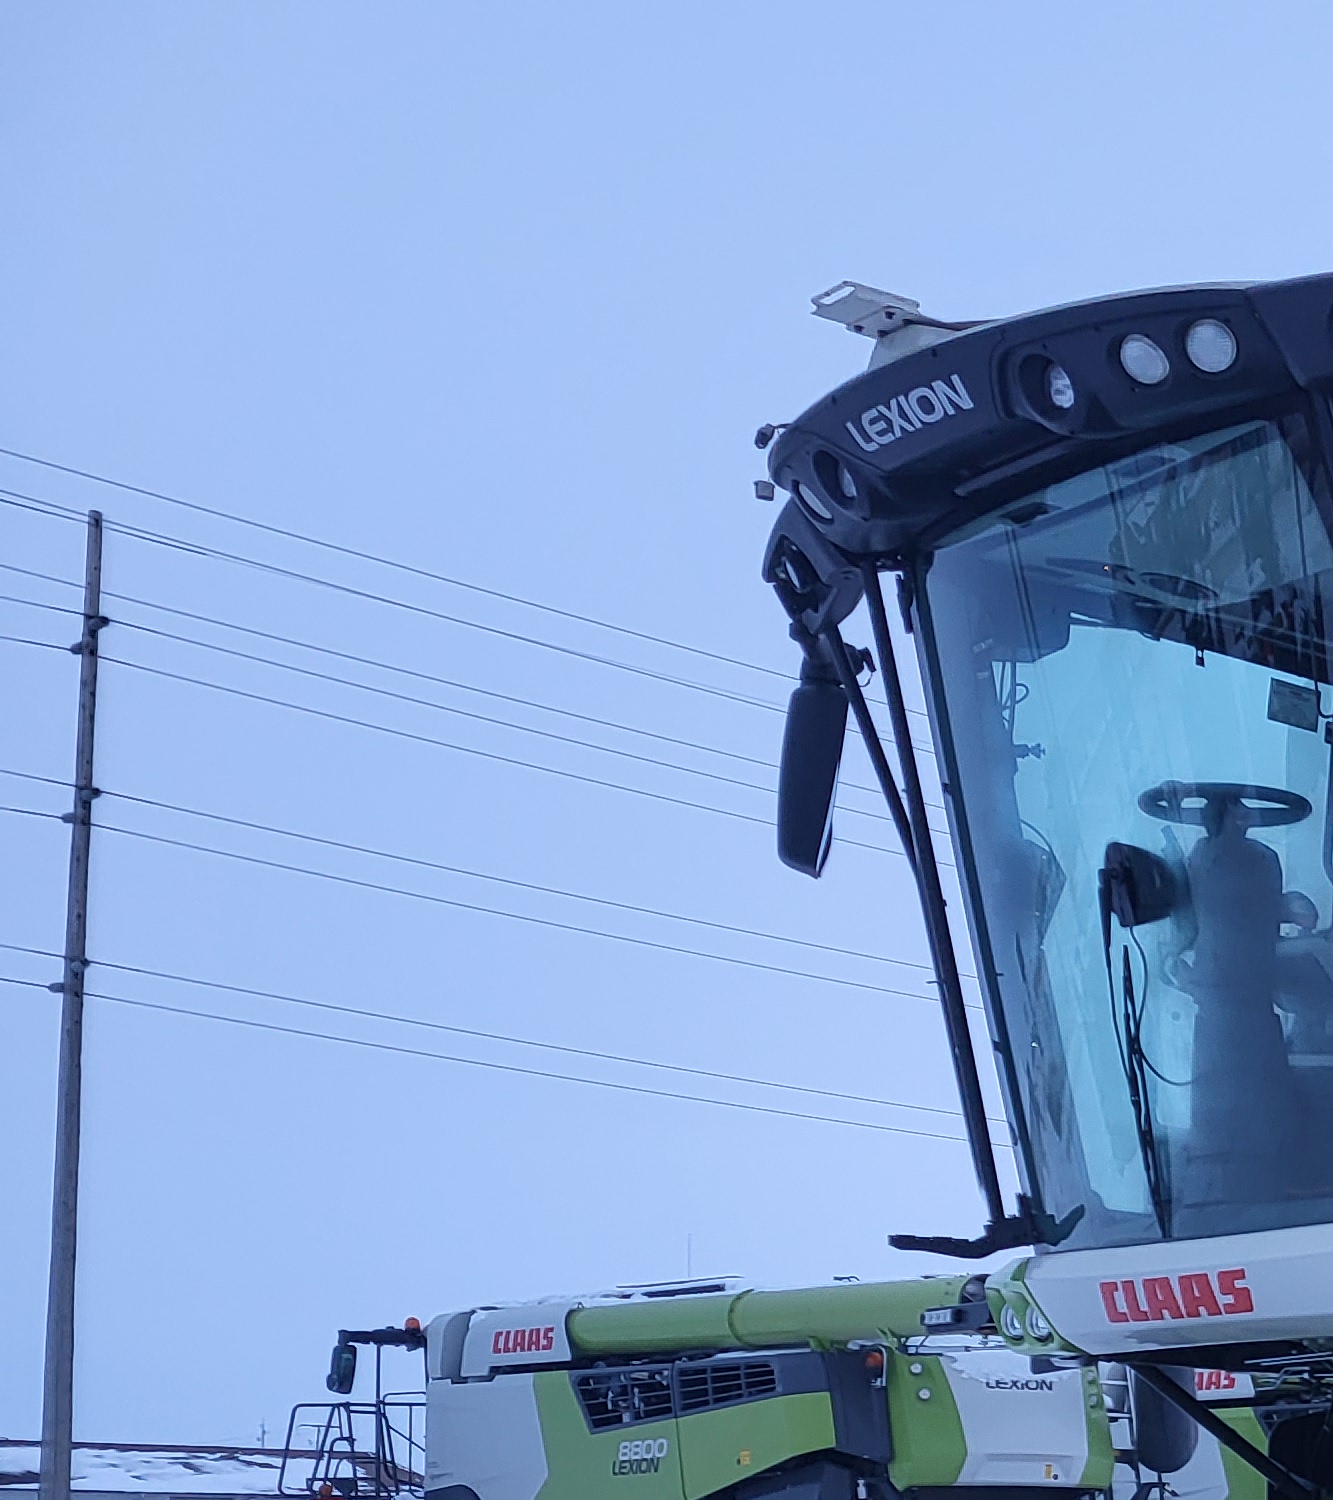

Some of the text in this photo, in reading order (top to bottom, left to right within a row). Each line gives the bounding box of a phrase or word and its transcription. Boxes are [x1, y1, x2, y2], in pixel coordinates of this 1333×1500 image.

[845, 373, 974, 453] LEXION
[1099, 1268, 1254, 1323] CLAAS
[492, 1326, 555, 1354] CLAAS
[618, 1438, 668, 1460] 8800
[612, 1457, 661, 1477] LEXION
